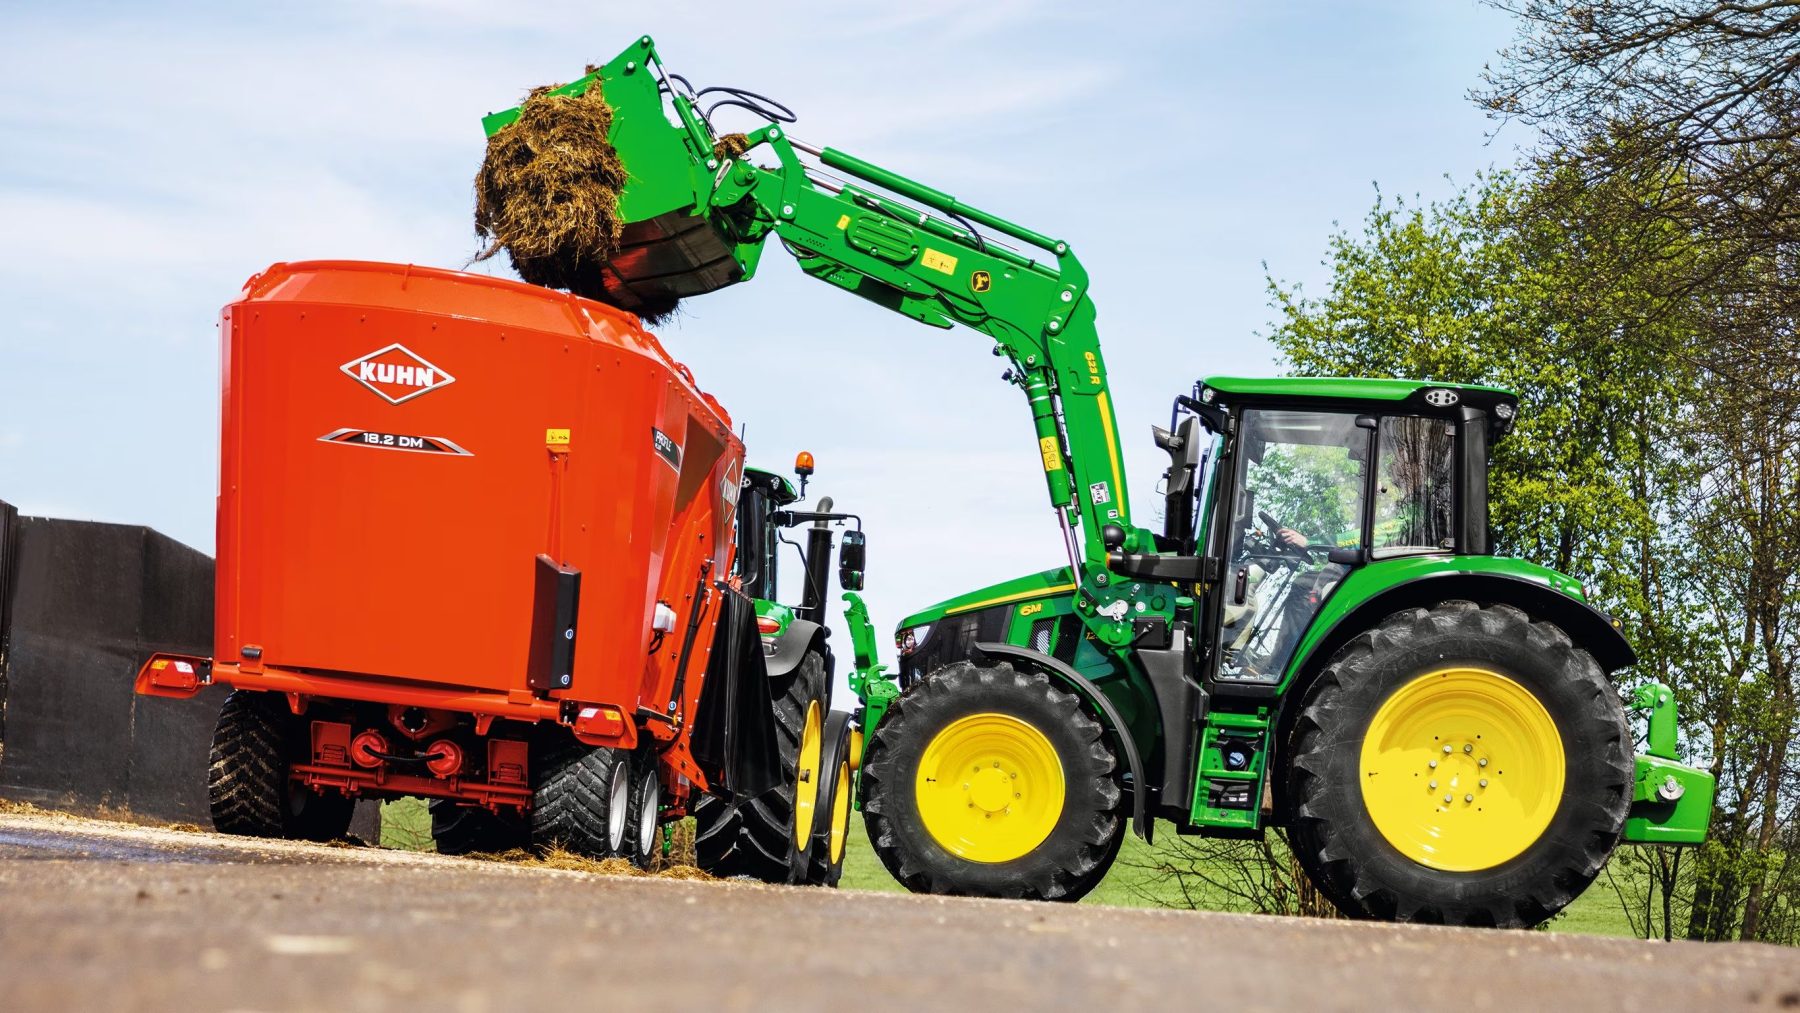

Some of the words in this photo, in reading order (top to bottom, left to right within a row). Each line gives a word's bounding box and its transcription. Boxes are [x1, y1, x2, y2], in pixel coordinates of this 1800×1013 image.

[360, 361, 434, 387] KUHN
[1090, 375, 1101, 385] R
[363, 432, 394, 446] 18.2
[399, 436, 423, 449] DM
[1020, 603, 1042, 616] 6M
